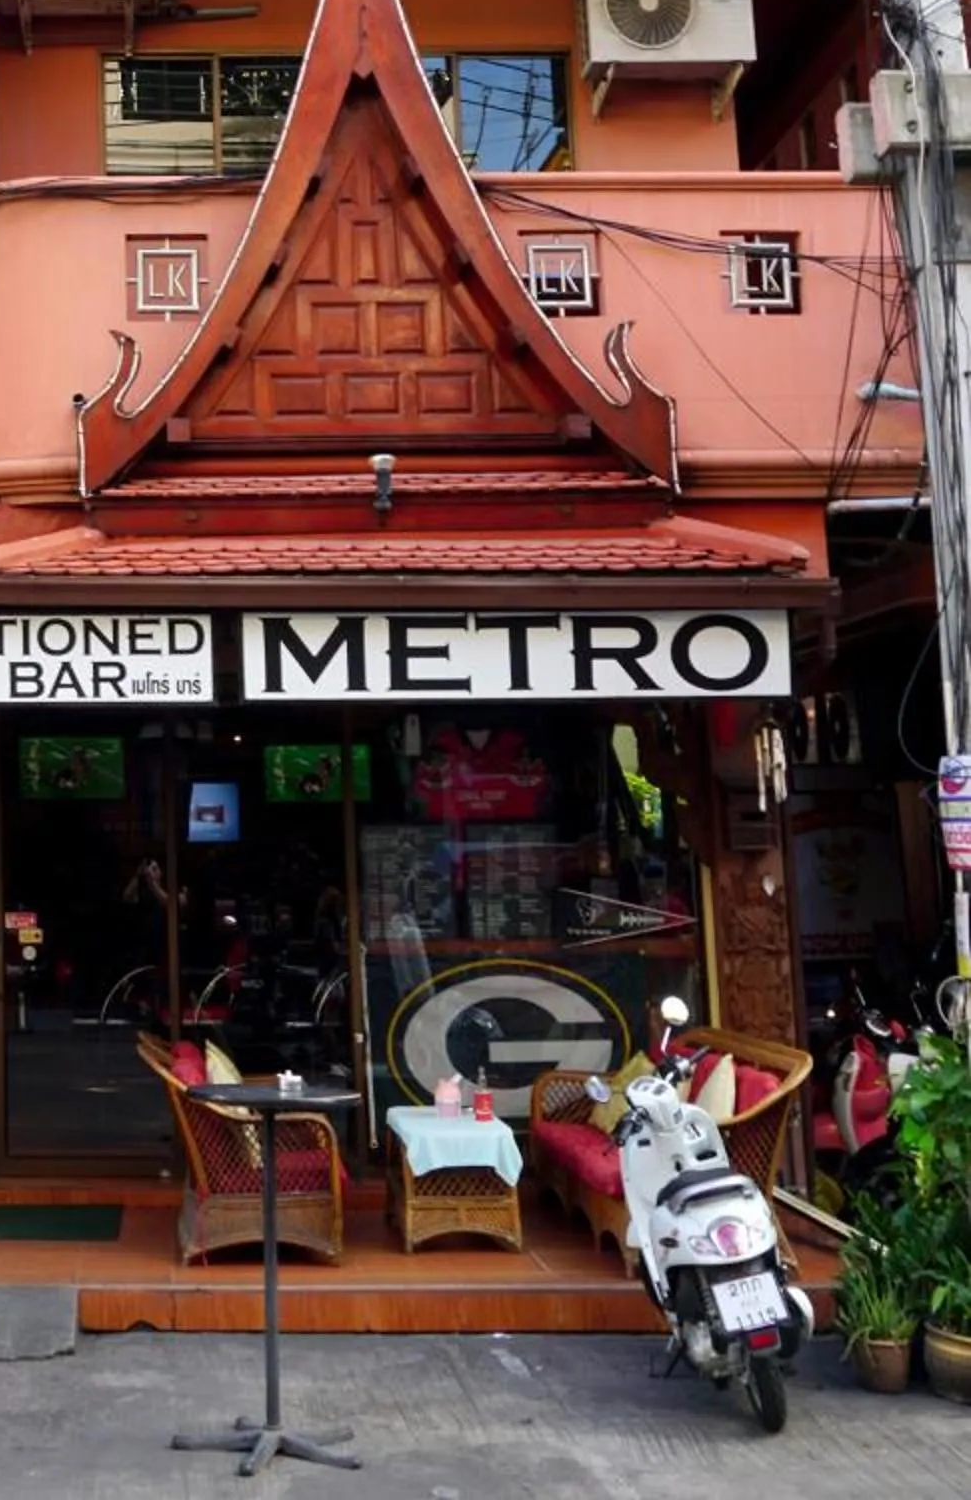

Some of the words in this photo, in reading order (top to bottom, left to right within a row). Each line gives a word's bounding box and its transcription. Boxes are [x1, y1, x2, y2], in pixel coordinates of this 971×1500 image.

[149, 263, 186, 297] LK
[541, 258, 580, 293] LK
[743, 257, 782, 292] LK
[261, 613, 770, 693] METRO
[9, 661, 128, 699] BAR
[403, 974, 613, 1119] G
